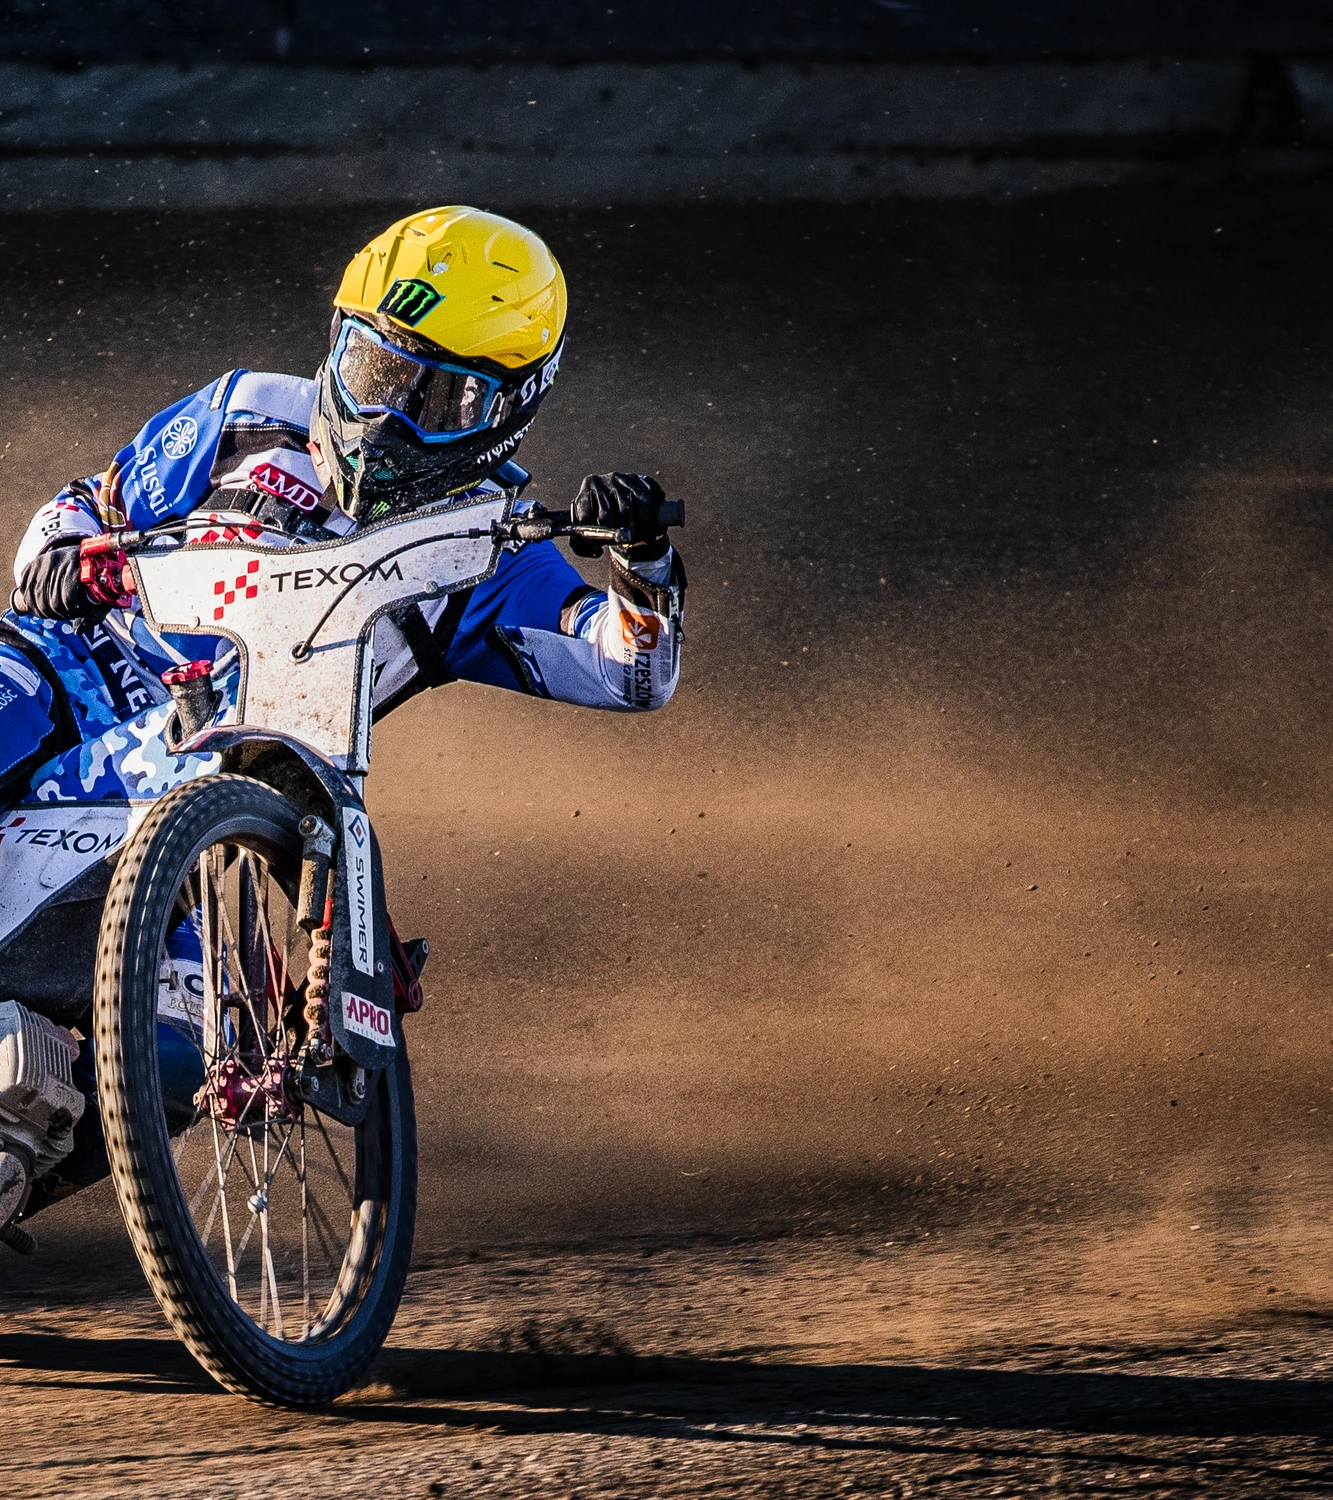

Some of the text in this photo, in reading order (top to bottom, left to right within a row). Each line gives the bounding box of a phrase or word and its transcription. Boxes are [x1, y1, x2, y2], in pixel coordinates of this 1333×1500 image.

[136, 446, 173, 518] Sushi
[253, 467, 319, 511] AMD
[270, 560, 404, 592] TEXOM
[15, 829, 126, 854] TEXOM
[355, 856, 368, 964] SWIMER
[346, 996, 389, 1036] APRO
